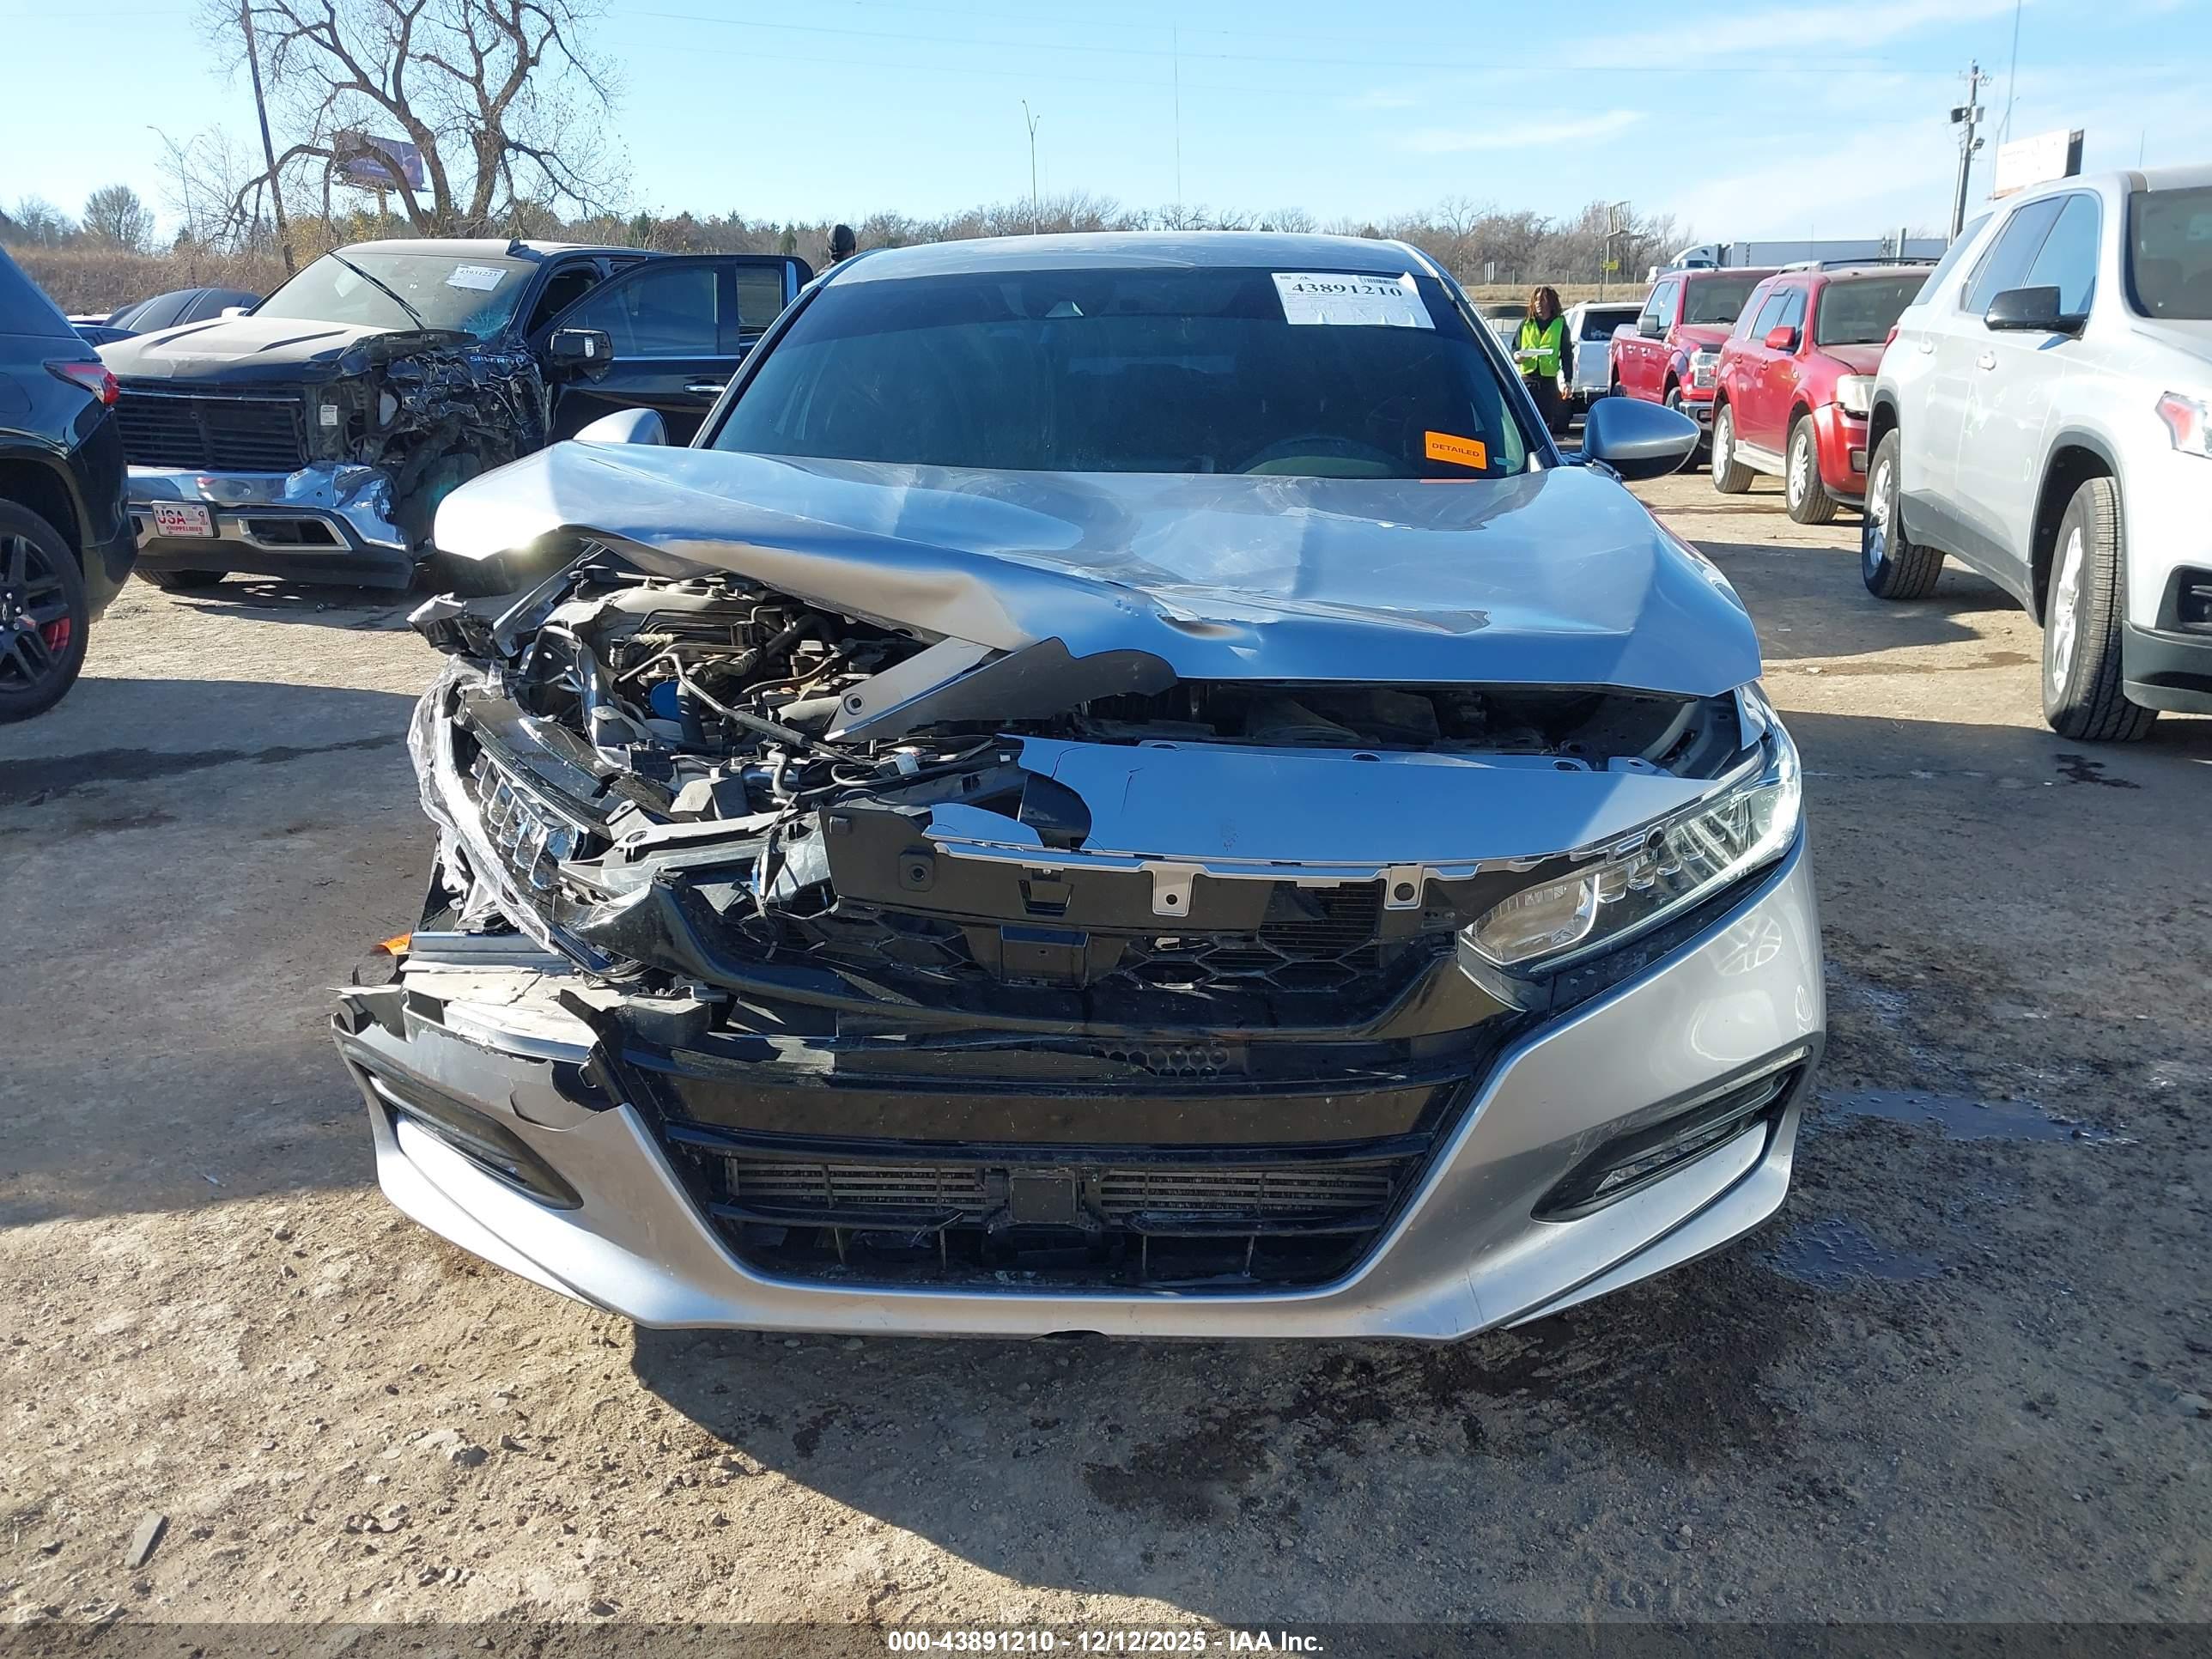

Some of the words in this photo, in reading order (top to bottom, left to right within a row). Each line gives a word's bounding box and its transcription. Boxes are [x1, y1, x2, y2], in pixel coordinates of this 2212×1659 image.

[1291, 283, 1403, 297] 43891210
[1431, 442, 1480, 457] DETAILED
[155, 509, 186, 525] USA
